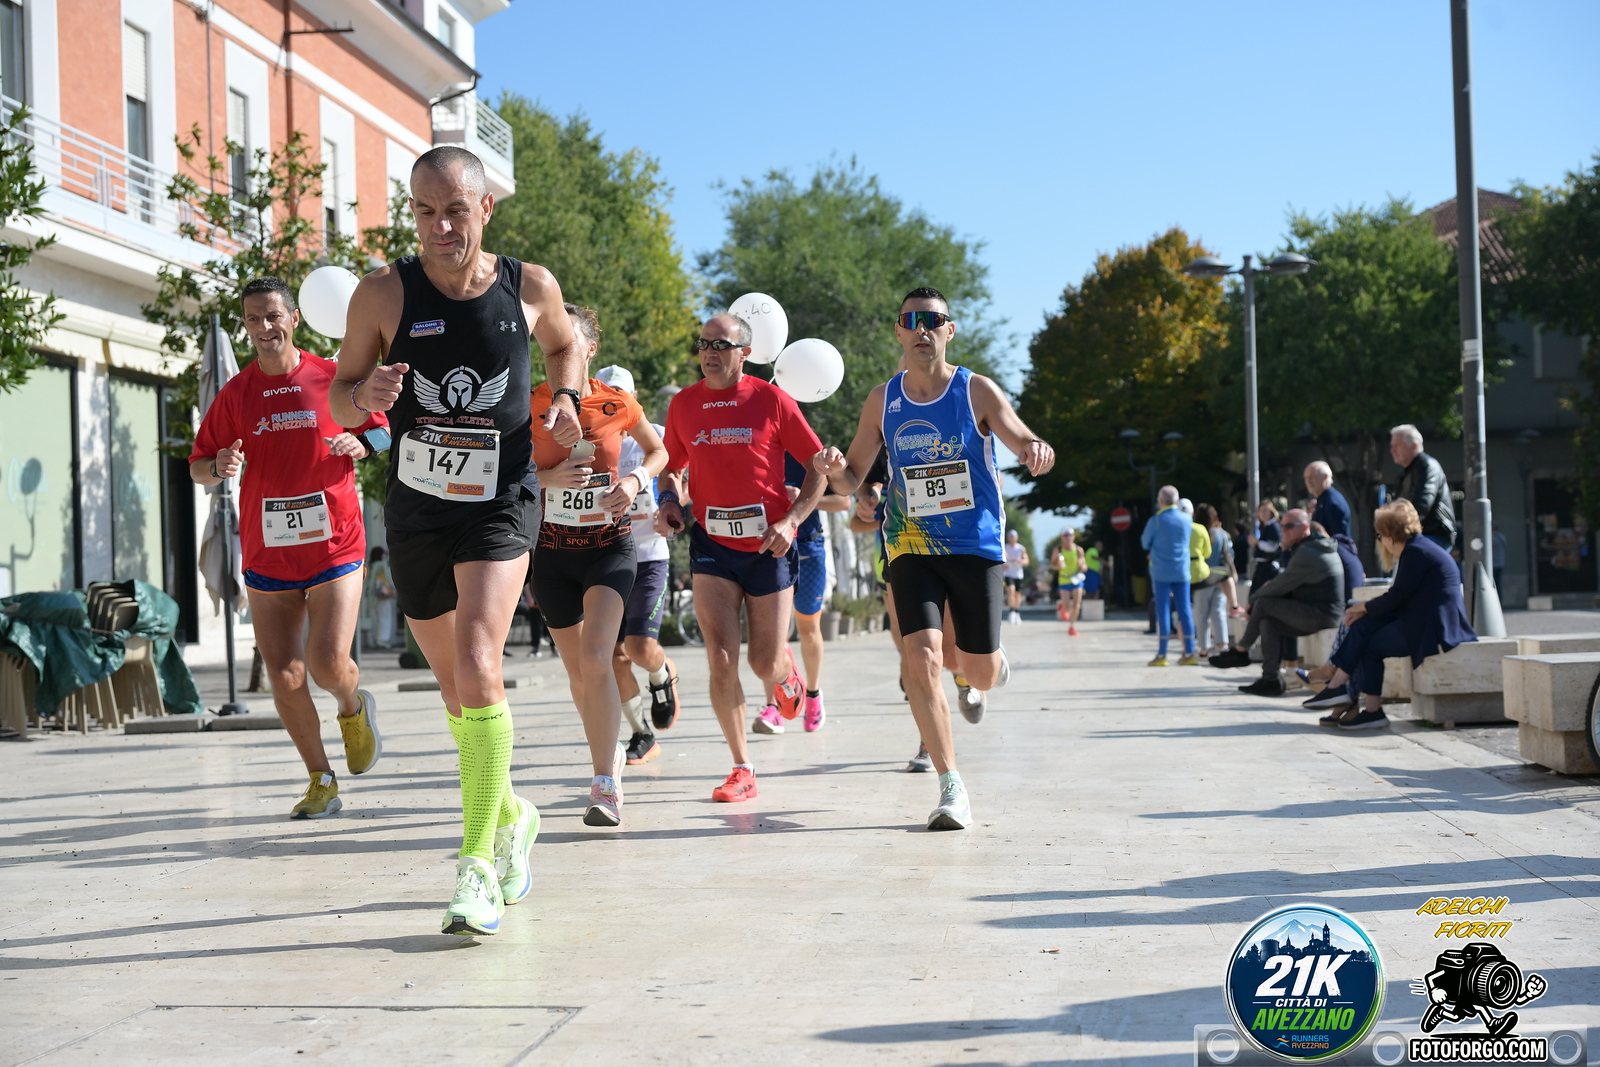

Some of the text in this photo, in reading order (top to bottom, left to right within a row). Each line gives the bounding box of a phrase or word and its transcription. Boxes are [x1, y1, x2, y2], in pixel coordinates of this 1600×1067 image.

[263, 386, 301, 397] GIVOVA
[702, 400, 737, 409] GIVOVA
[271, 410, 316, 423] RUNNERS
[272, 420, 317, 432] AVEZZANO
[420, 430, 443, 444] 21K
[711, 428, 752, 437] RUNNERS
[711, 436, 752, 445] AVEZZANO
[428, 448, 471, 476] 147
[914, 469, 928, 478] 21K
[925, 478, 946, 497] 83
[563, 491, 594, 510] 268
[272, 502, 287, 511] 21K
[286, 512, 304, 529] 21
[715, 511, 729, 519] 21K
[728, 521, 743, 536] 10
[566, 537, 589, 546] SPQR
